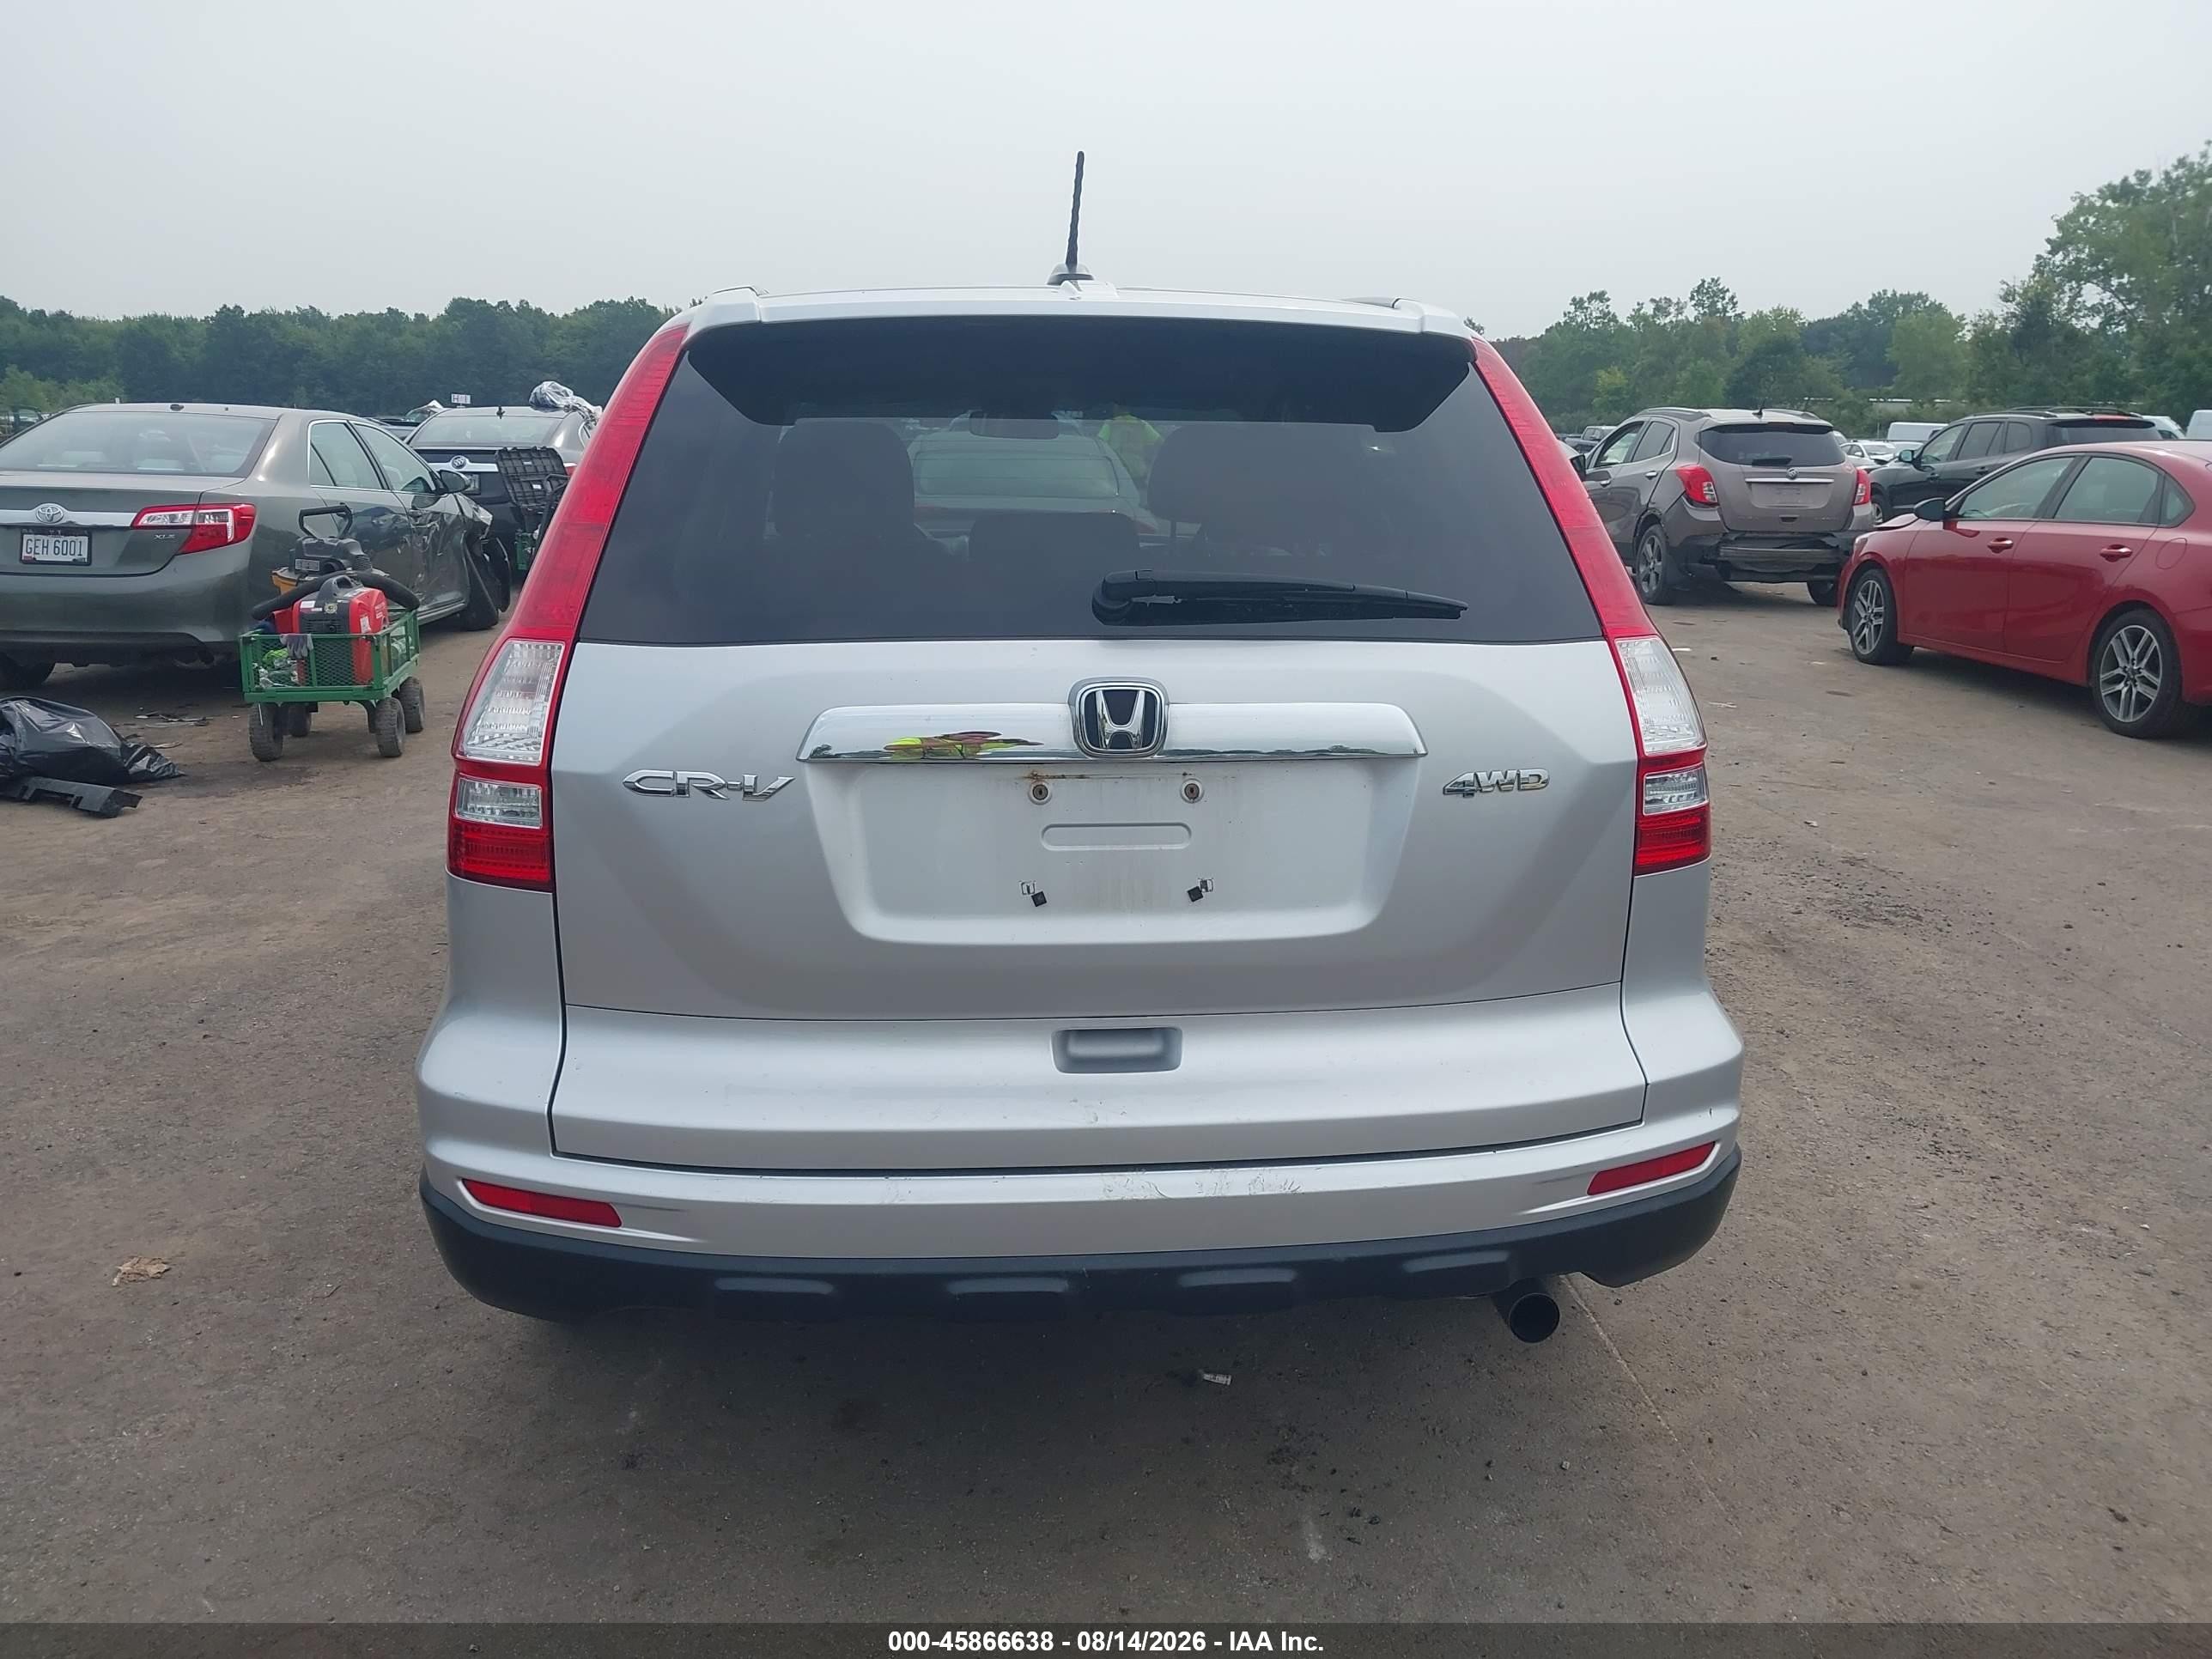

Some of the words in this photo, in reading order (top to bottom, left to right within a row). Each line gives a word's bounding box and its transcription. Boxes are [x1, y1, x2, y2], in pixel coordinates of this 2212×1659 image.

[26, 538, 49, 556] GEH
[53, 539, 83, 556] 6001
[623, 769, 795, 801] CR-V
[1443, 768, 1550, 798] 4WD
